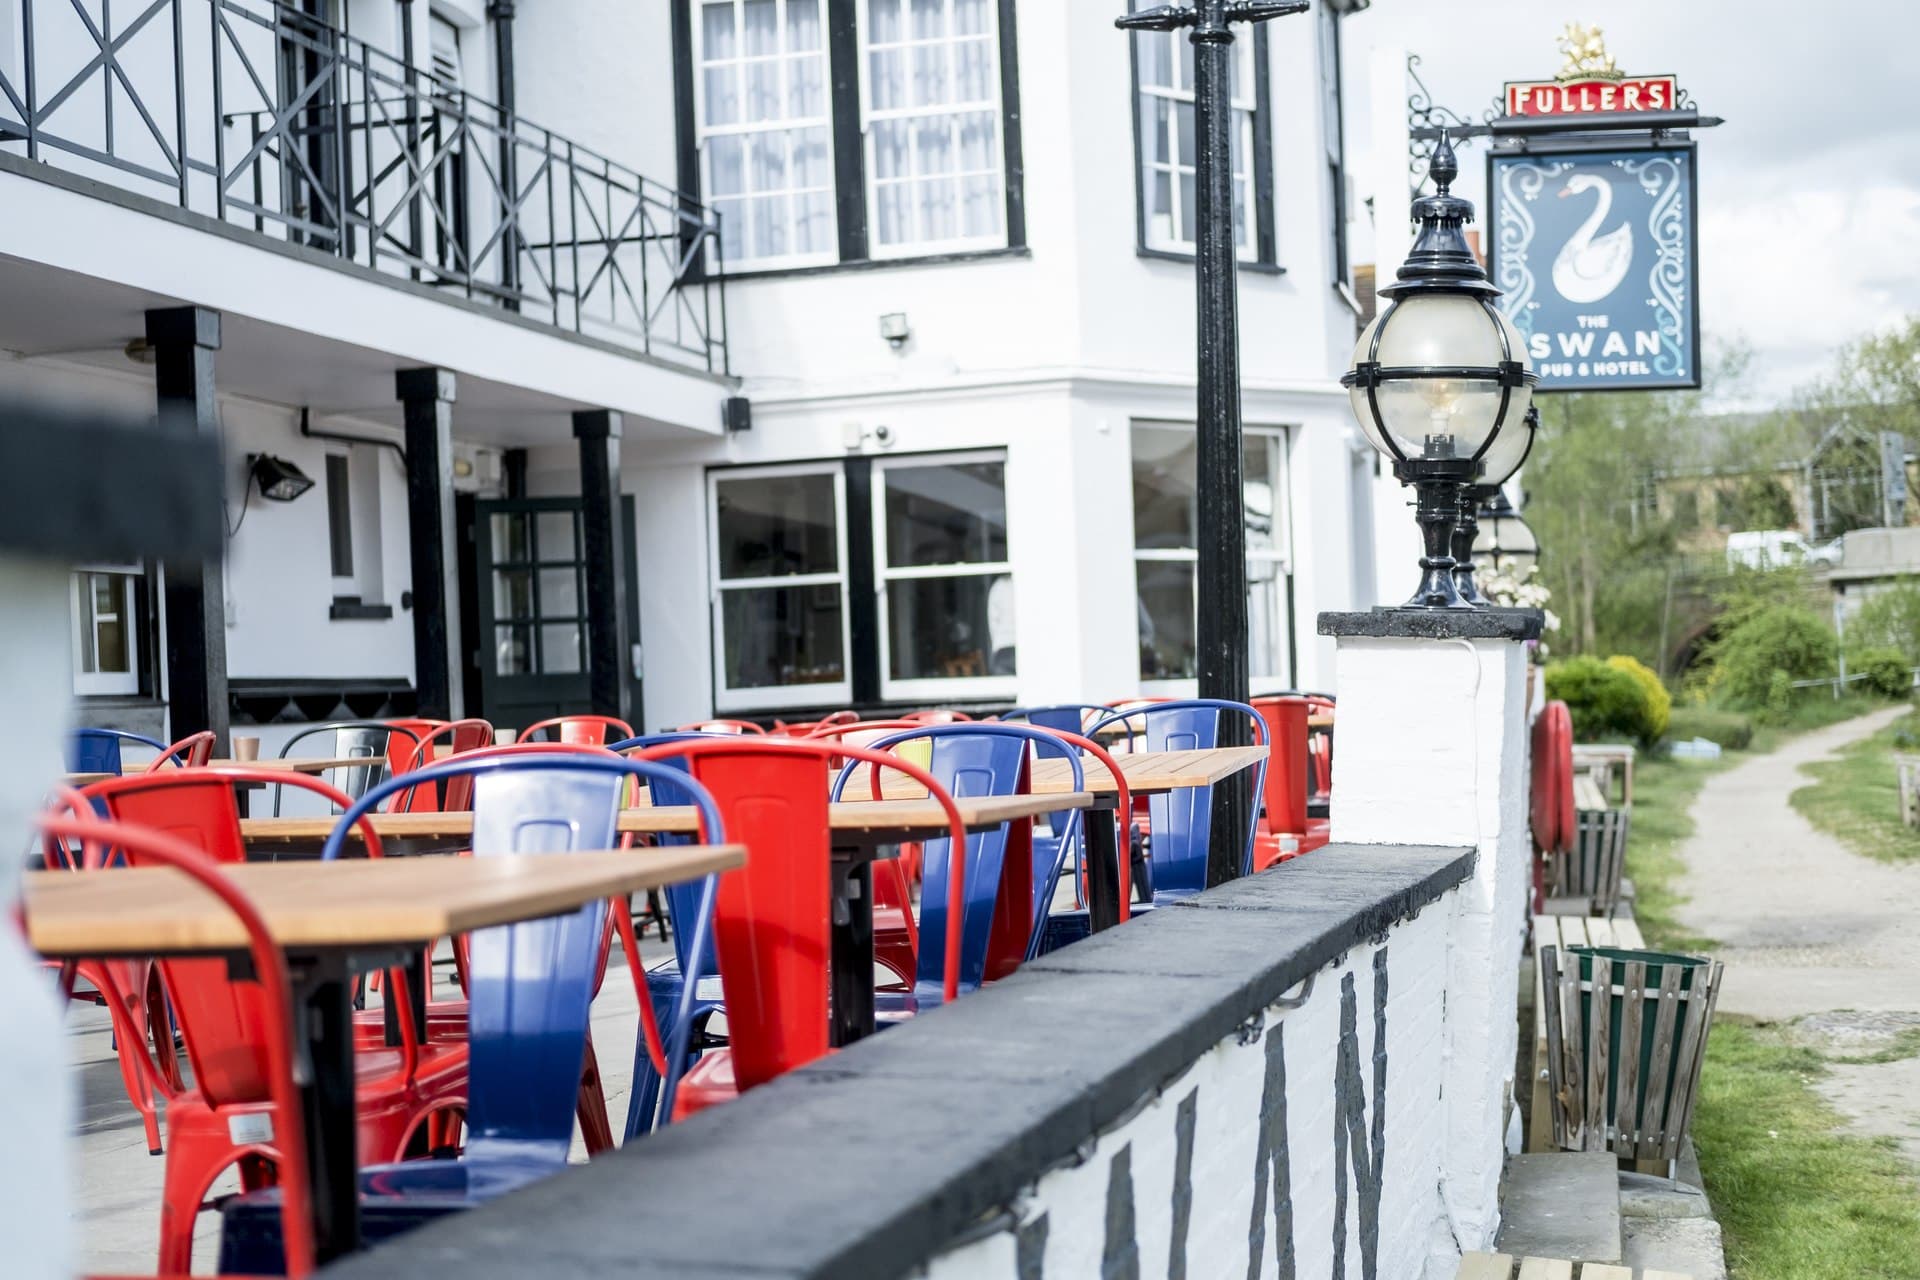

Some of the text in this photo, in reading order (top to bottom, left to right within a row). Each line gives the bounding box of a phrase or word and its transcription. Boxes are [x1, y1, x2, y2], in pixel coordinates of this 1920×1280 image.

[1515, 83, 1665, 114] FULLER'S
[1576, 315, 1609, 329] THE
[1529, 331, 1661, 359] SWAN
[1540, 361, 1650, 377] PUB & HOTEL
